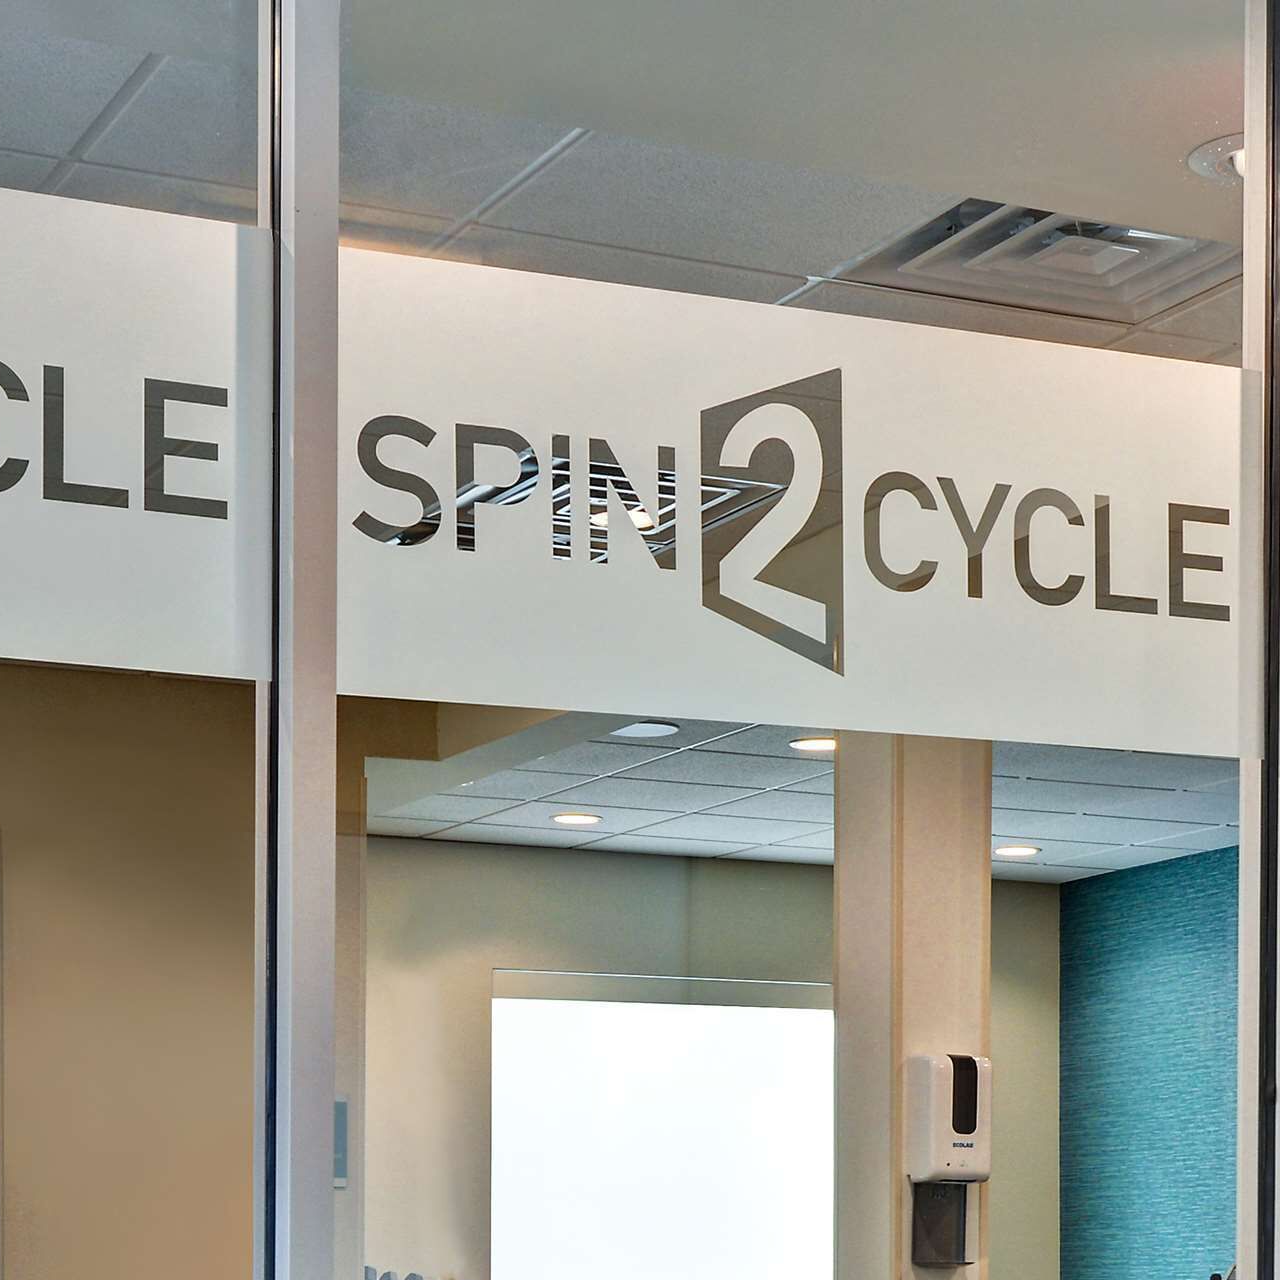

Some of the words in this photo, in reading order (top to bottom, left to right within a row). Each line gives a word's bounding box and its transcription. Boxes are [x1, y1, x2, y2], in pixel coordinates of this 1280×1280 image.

[351, 415, 677, 571] SPIN
[719, 402, 827, 645] 2
[862, 471, 1231, 622] CYCLE
